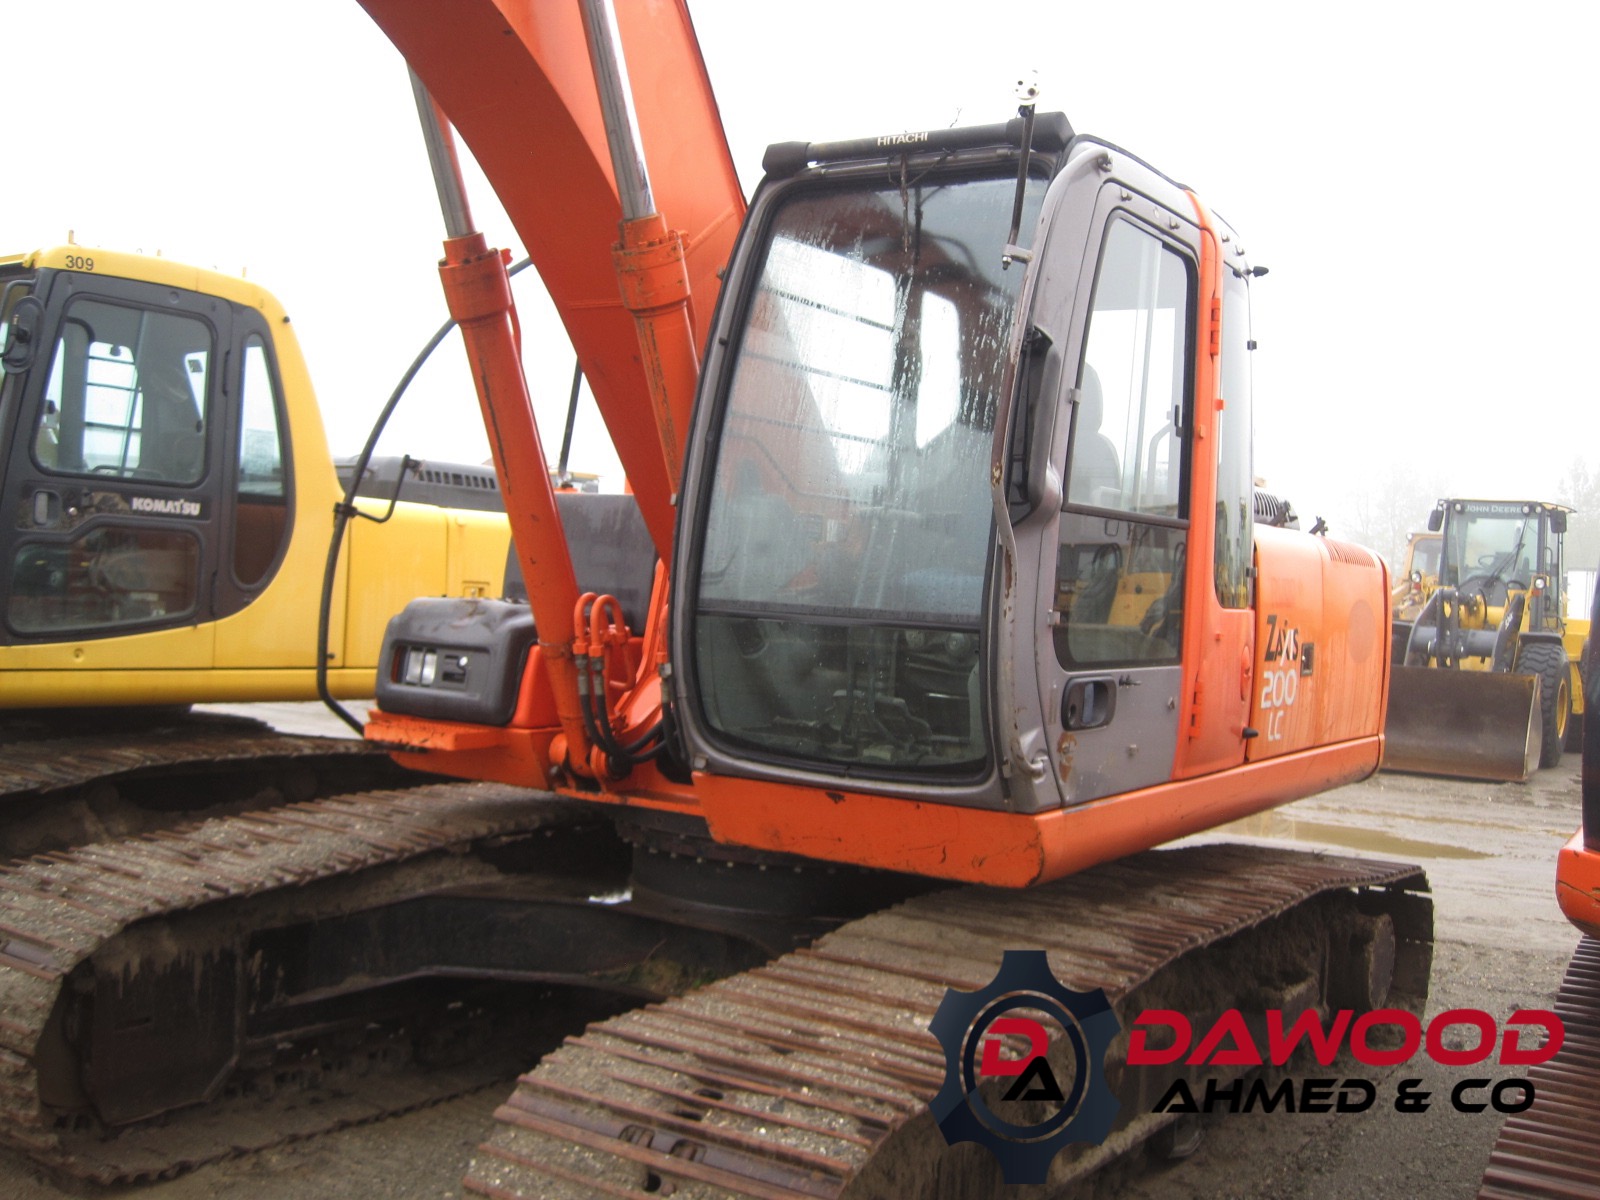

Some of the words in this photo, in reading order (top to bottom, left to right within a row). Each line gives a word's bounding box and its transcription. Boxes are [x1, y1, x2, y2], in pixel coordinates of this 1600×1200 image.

[877, 132, 929, 147] HITACHI
[65, 254, 94, 272] 309
[132, 497, 201, 516] KOMATSU
[1466, 504, 1489, 513] JOHN
[1491, 505, 1522, 514] DEERE
[1261, 669, 1297, 709] 200
[1267, 710, 1284, 742] LC
